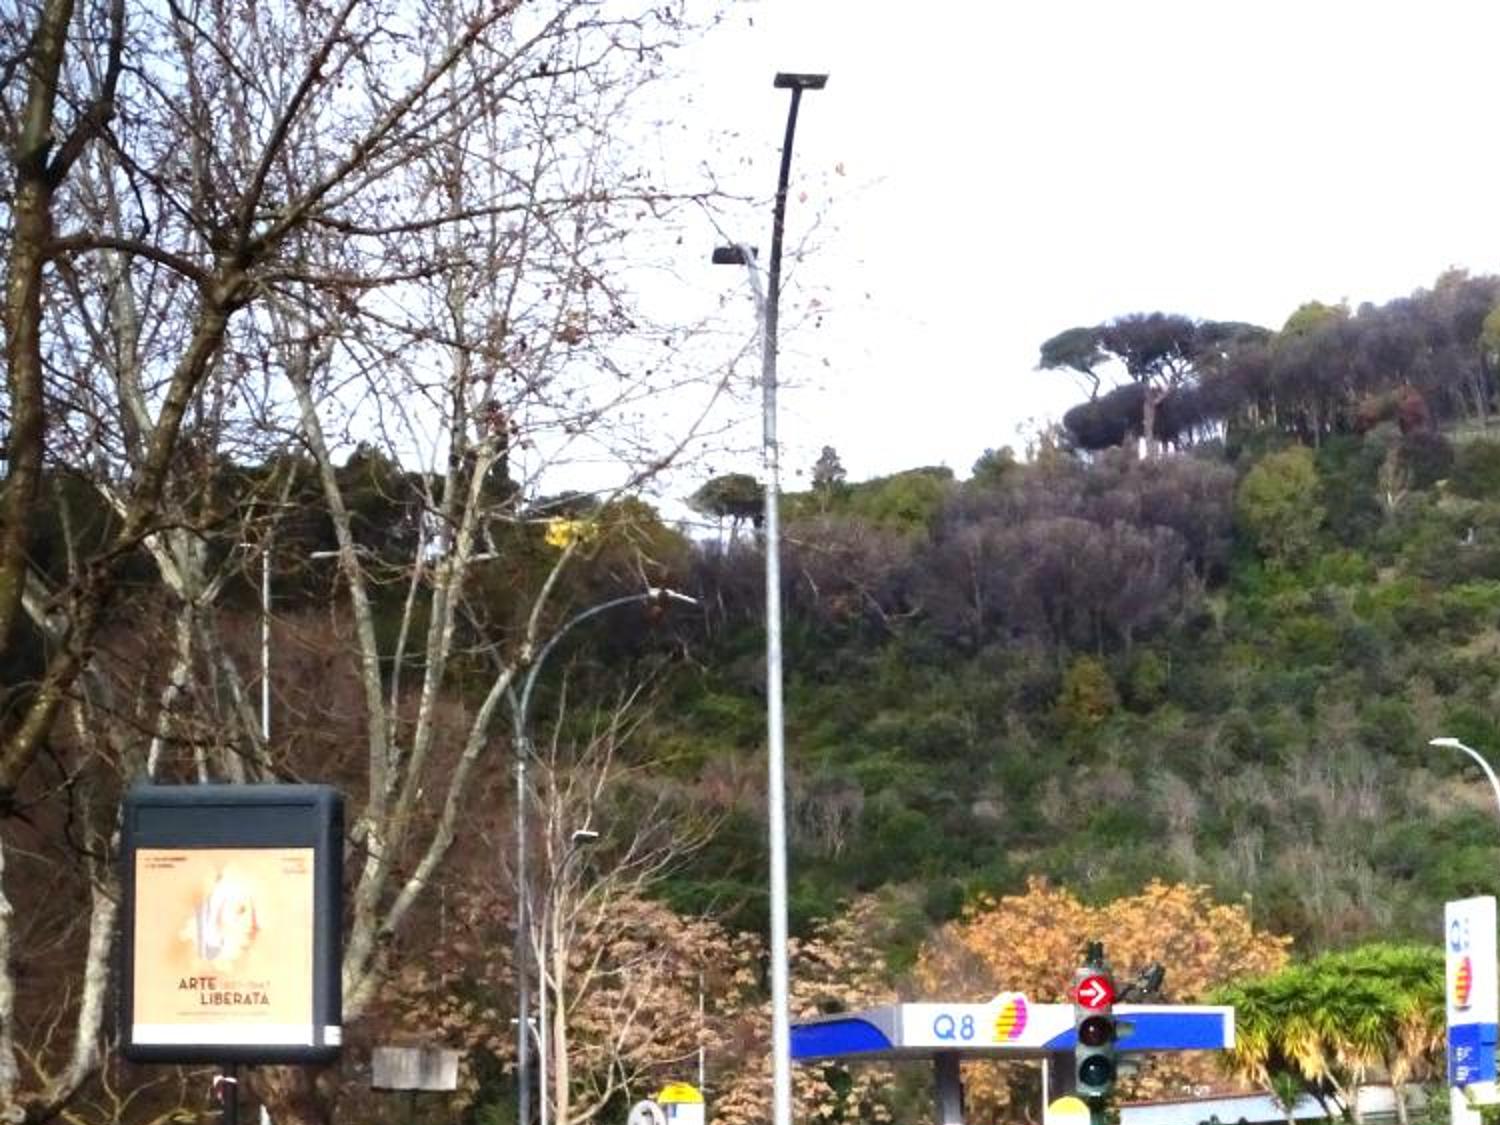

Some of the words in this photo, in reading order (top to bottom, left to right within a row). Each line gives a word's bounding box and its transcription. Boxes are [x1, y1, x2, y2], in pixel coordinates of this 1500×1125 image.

[179, 977, 217, 991] ARTE
[200, 992, 270, 1005] LIBERATA
[933, 1013, 975, 1040] Q8
